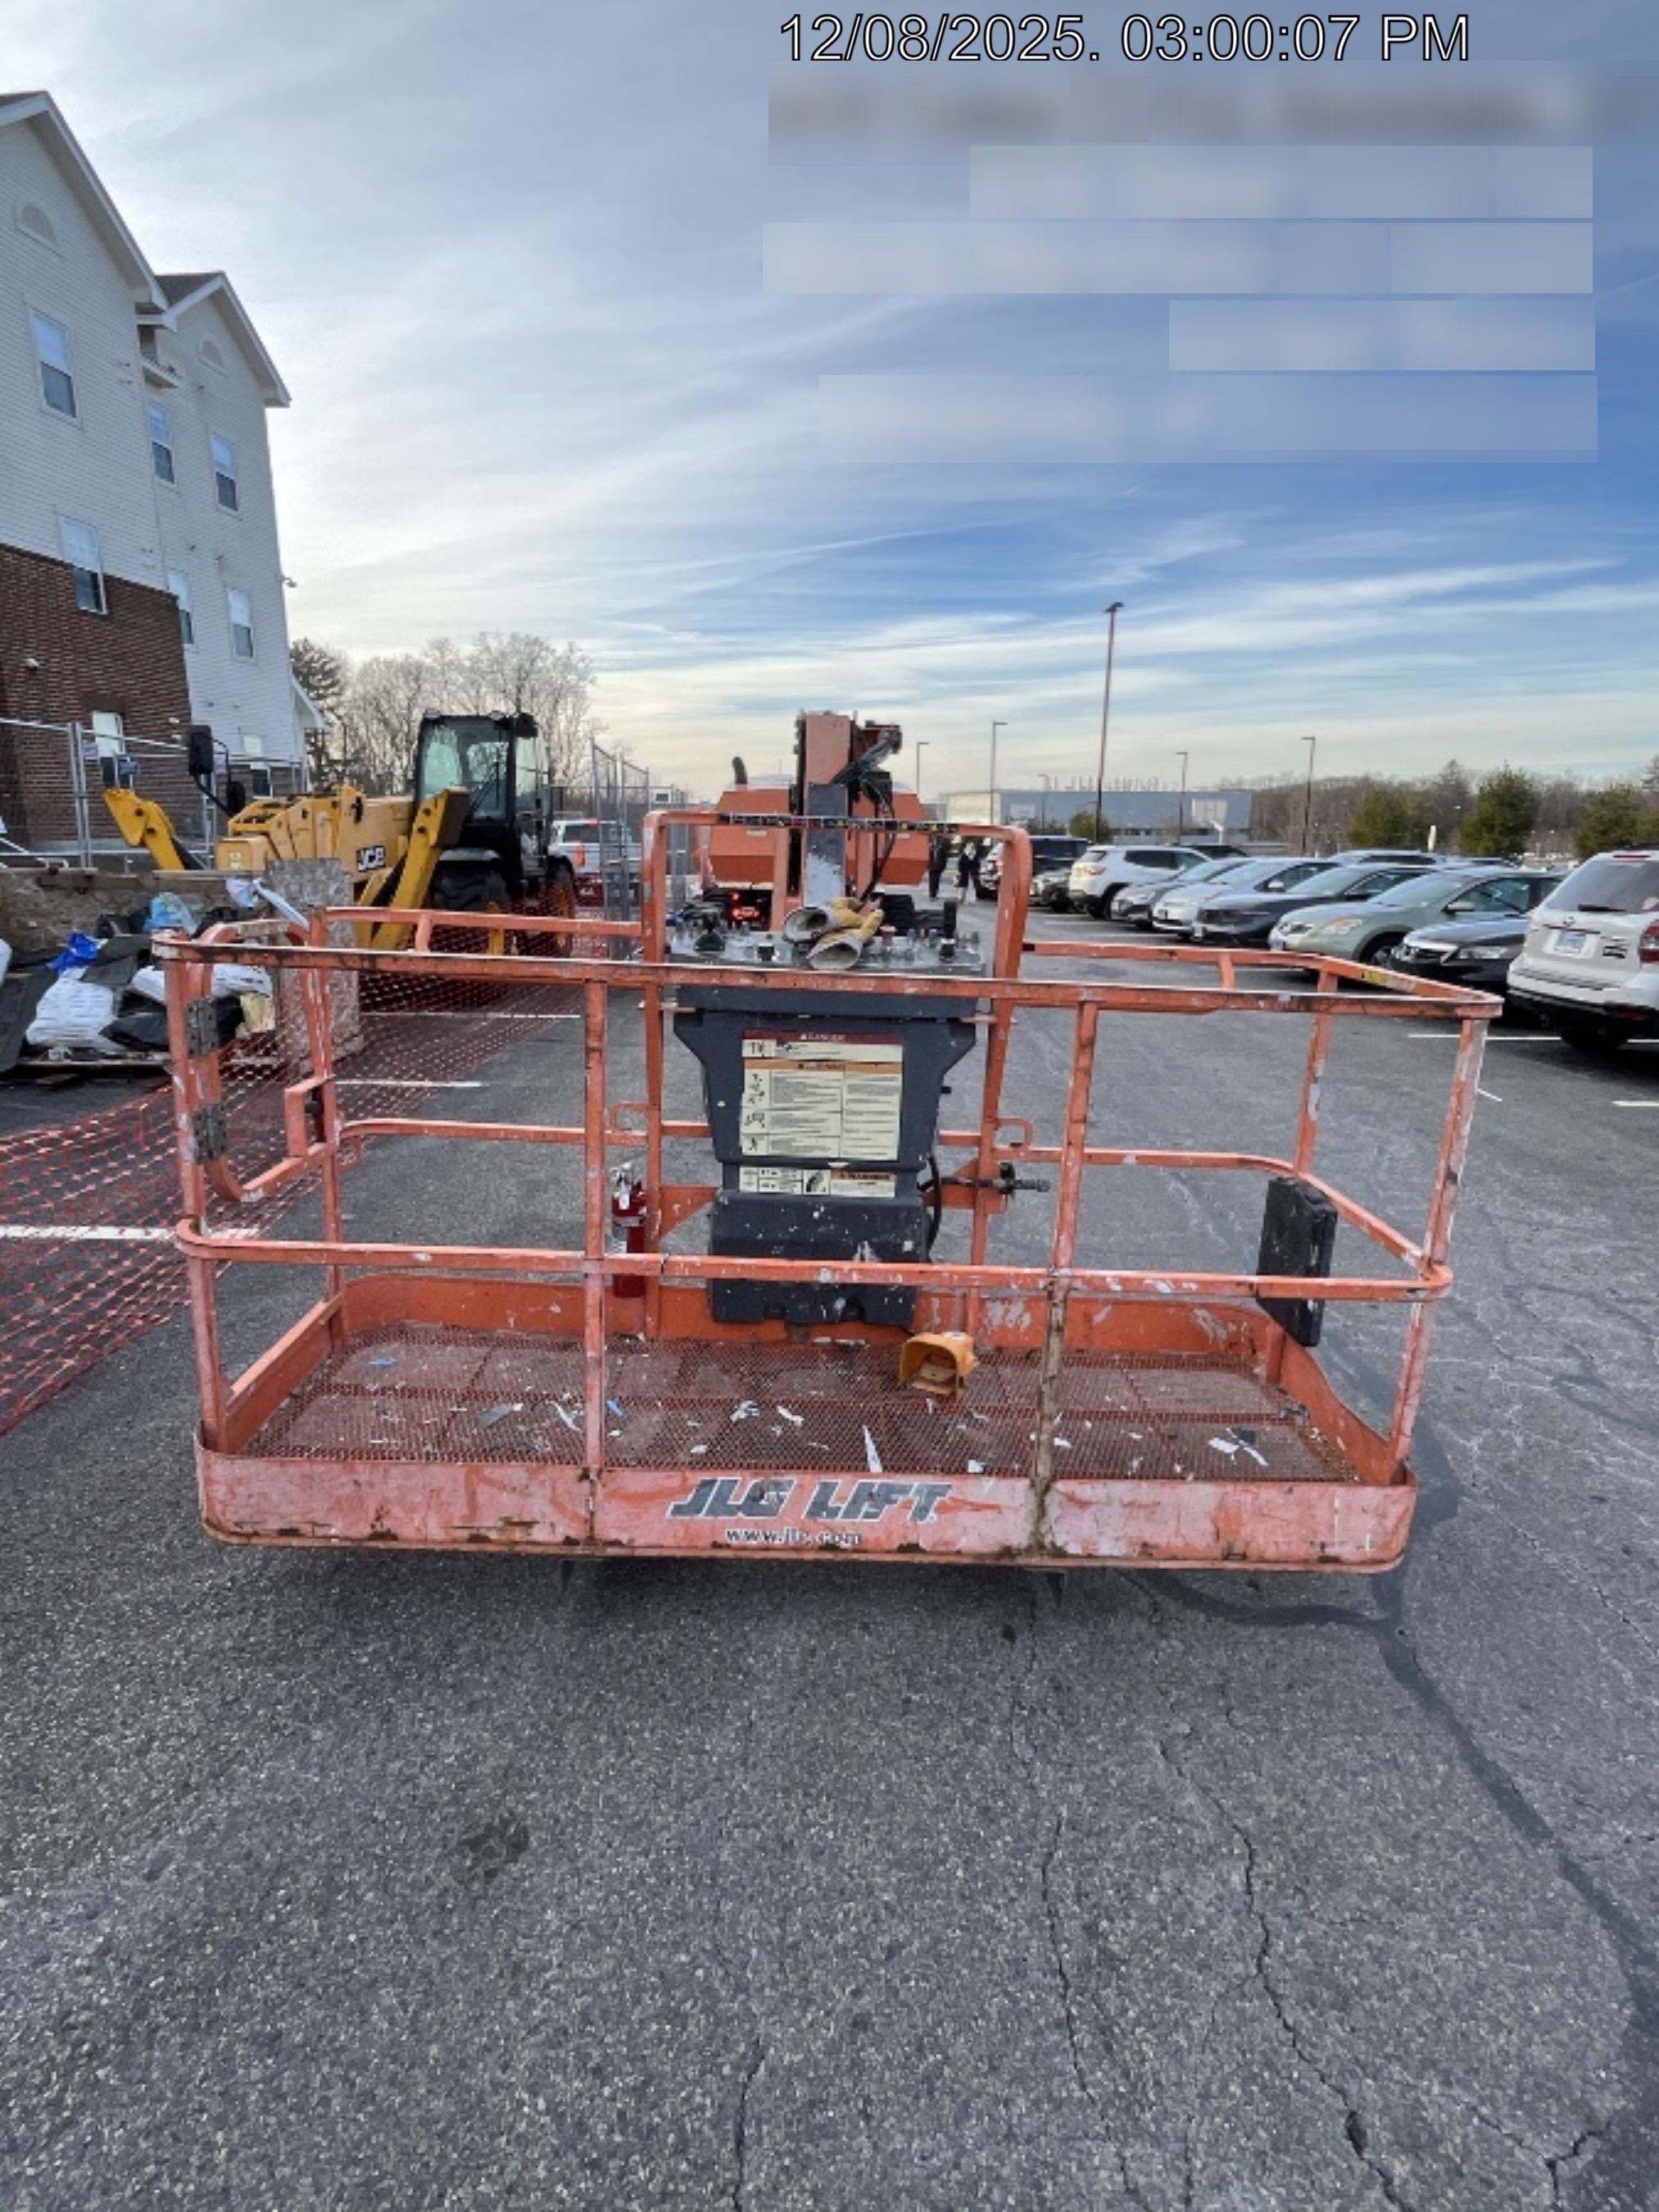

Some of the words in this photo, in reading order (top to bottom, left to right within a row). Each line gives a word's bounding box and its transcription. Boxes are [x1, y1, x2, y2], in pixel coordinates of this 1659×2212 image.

[356, 846, 385, 872] JCB
[667, 1477, 796, 1518] JLG
[801, 1480, 953, 1523] LIFT
